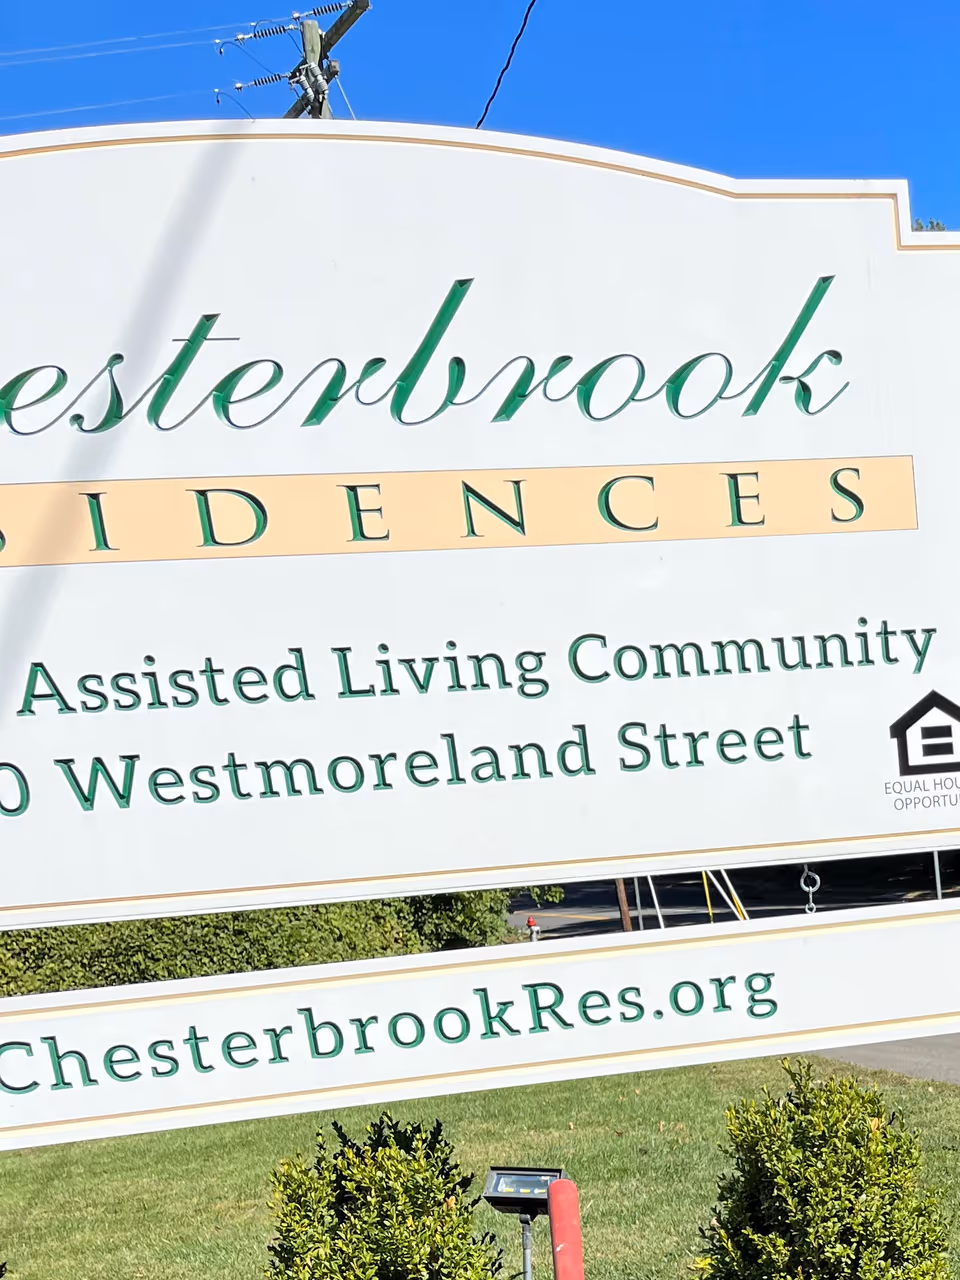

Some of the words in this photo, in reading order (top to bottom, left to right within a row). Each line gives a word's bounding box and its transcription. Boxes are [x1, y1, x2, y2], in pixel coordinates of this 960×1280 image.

[0, 468, 865, 553] IDENCES
[16, 647, 316, 717] Assisted
[330, 640, 550, 699] Living
[568, 617, 937, 684] Community
[53, 724, 596, 812] Westmoreland
[617, 714, 812, 772] Street
[884, 779, 930, 795] EQUAL
[0, 972, 778, 1095] ChesterbrookRes.org
